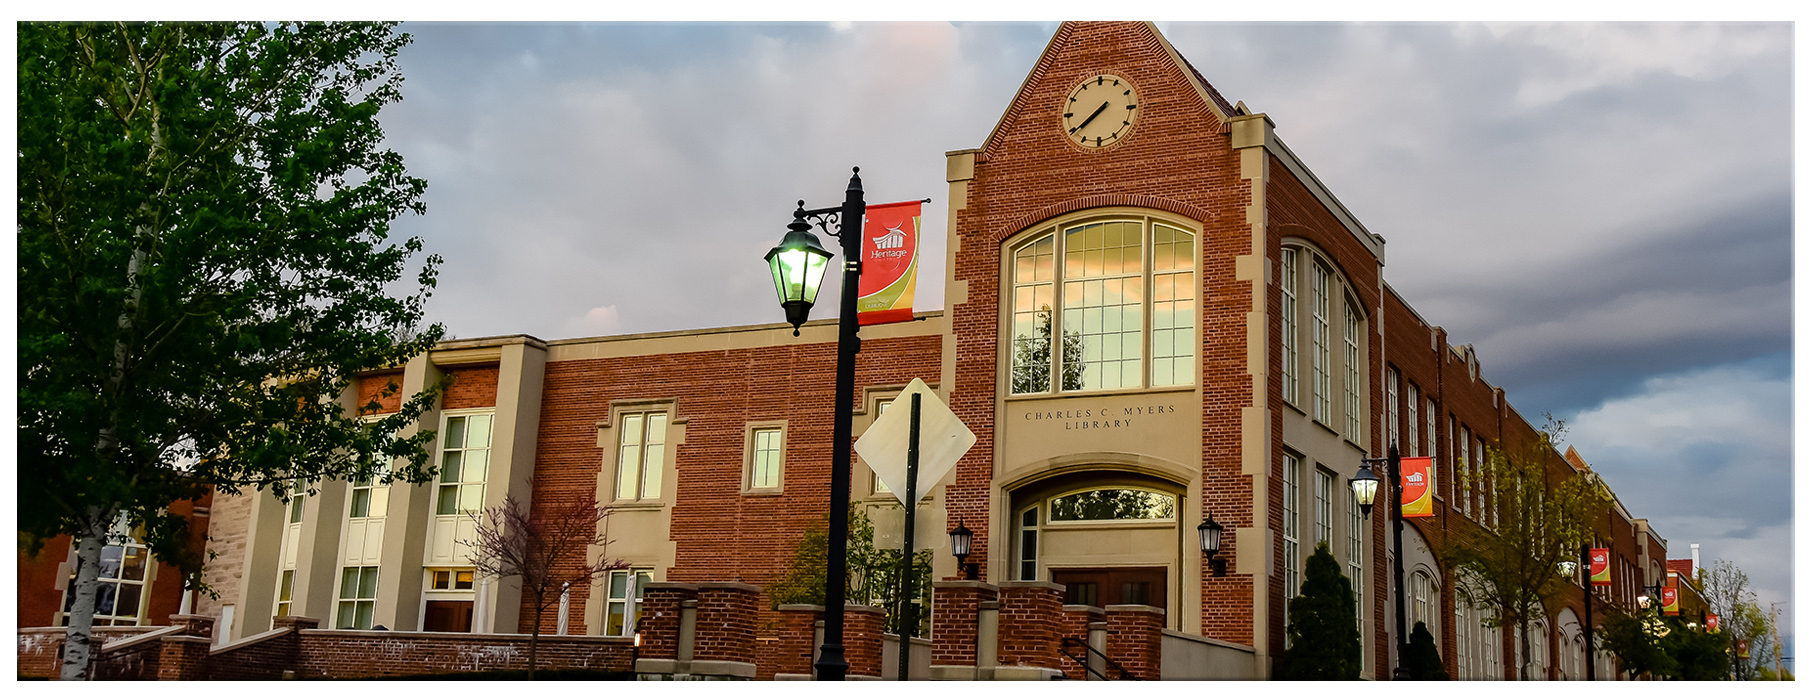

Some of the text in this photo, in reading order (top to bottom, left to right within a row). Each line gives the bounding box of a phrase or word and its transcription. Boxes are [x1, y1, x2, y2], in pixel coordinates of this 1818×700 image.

[870, 249, 908, 259] Heritage
[1024, 404, 1176, 421] CHARLES C. MYERS
[1065, 419, 1132, 430] LIBRARY
